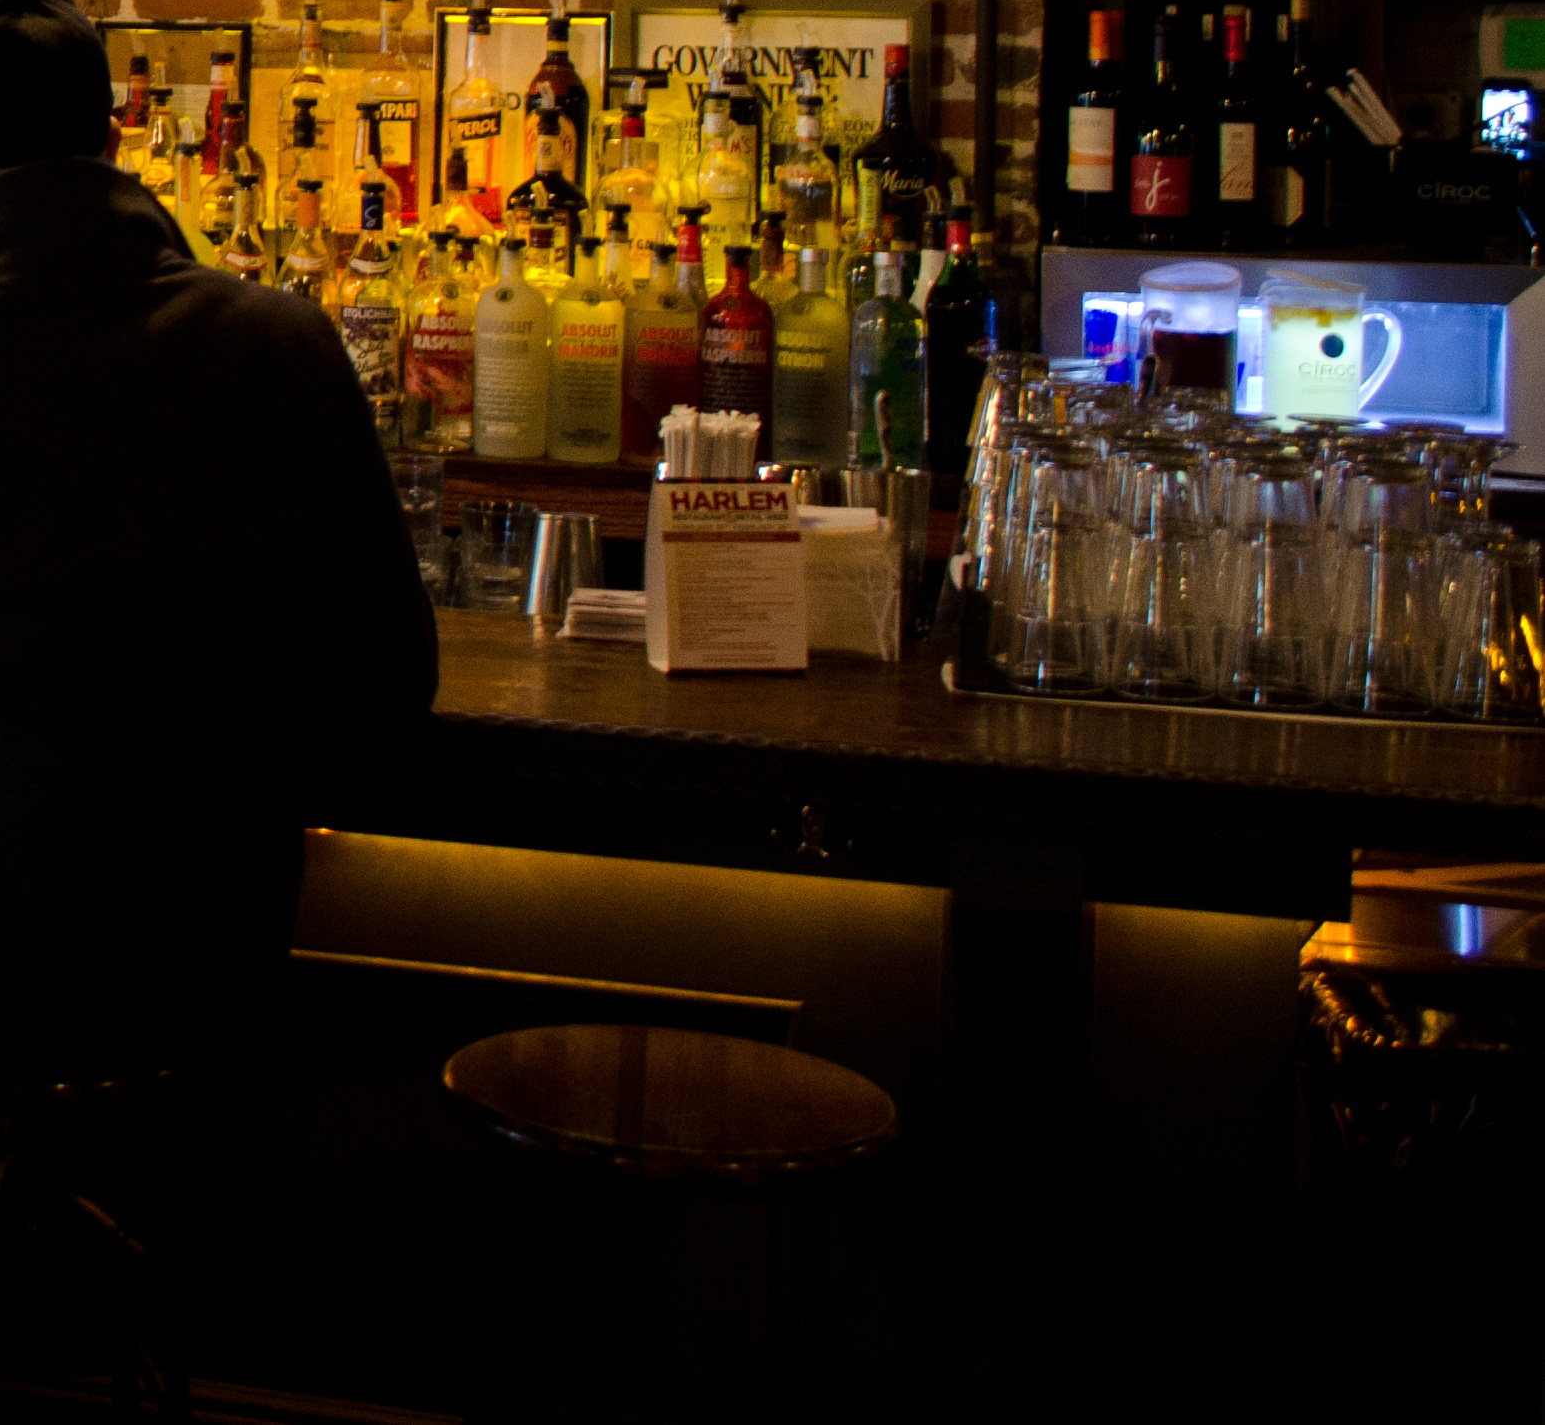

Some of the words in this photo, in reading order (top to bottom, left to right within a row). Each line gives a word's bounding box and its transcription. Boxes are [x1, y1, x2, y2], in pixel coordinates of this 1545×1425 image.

[456, 118, 498, 137] PEROL
[880, 170, 925, 190] Maria
[561, 324, 617, 338] ABSOLUT
[669, 490, 789, 512] HARLEM
